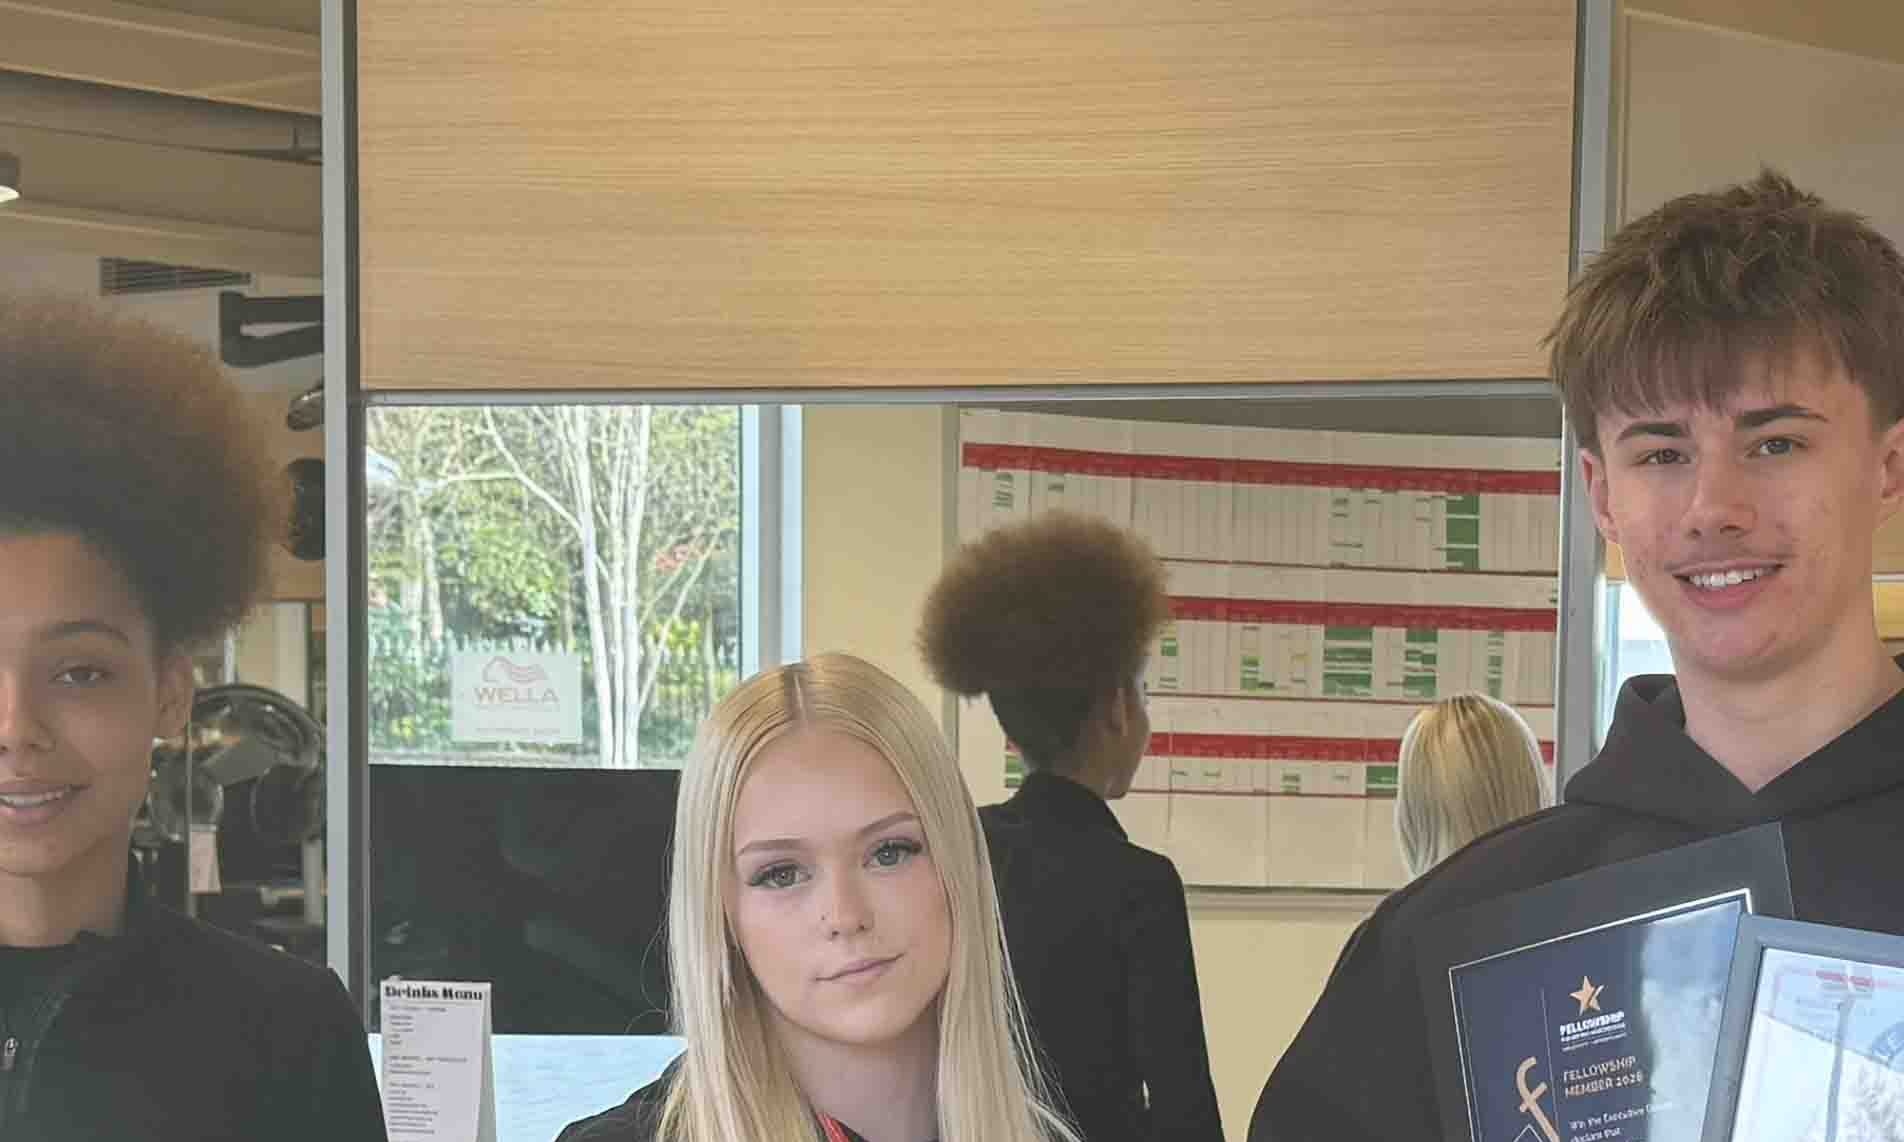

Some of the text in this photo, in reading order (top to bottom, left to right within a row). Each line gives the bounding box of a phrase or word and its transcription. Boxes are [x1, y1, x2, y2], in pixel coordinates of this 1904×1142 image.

[473, 687, 559, 704] WELLA
[385, 984, 483, 1001] Drinks Menu
[1563, 1055, 1636, 1084] FELLOWSHIP
[1565, 1077, 1614, 1099] MEMBER
